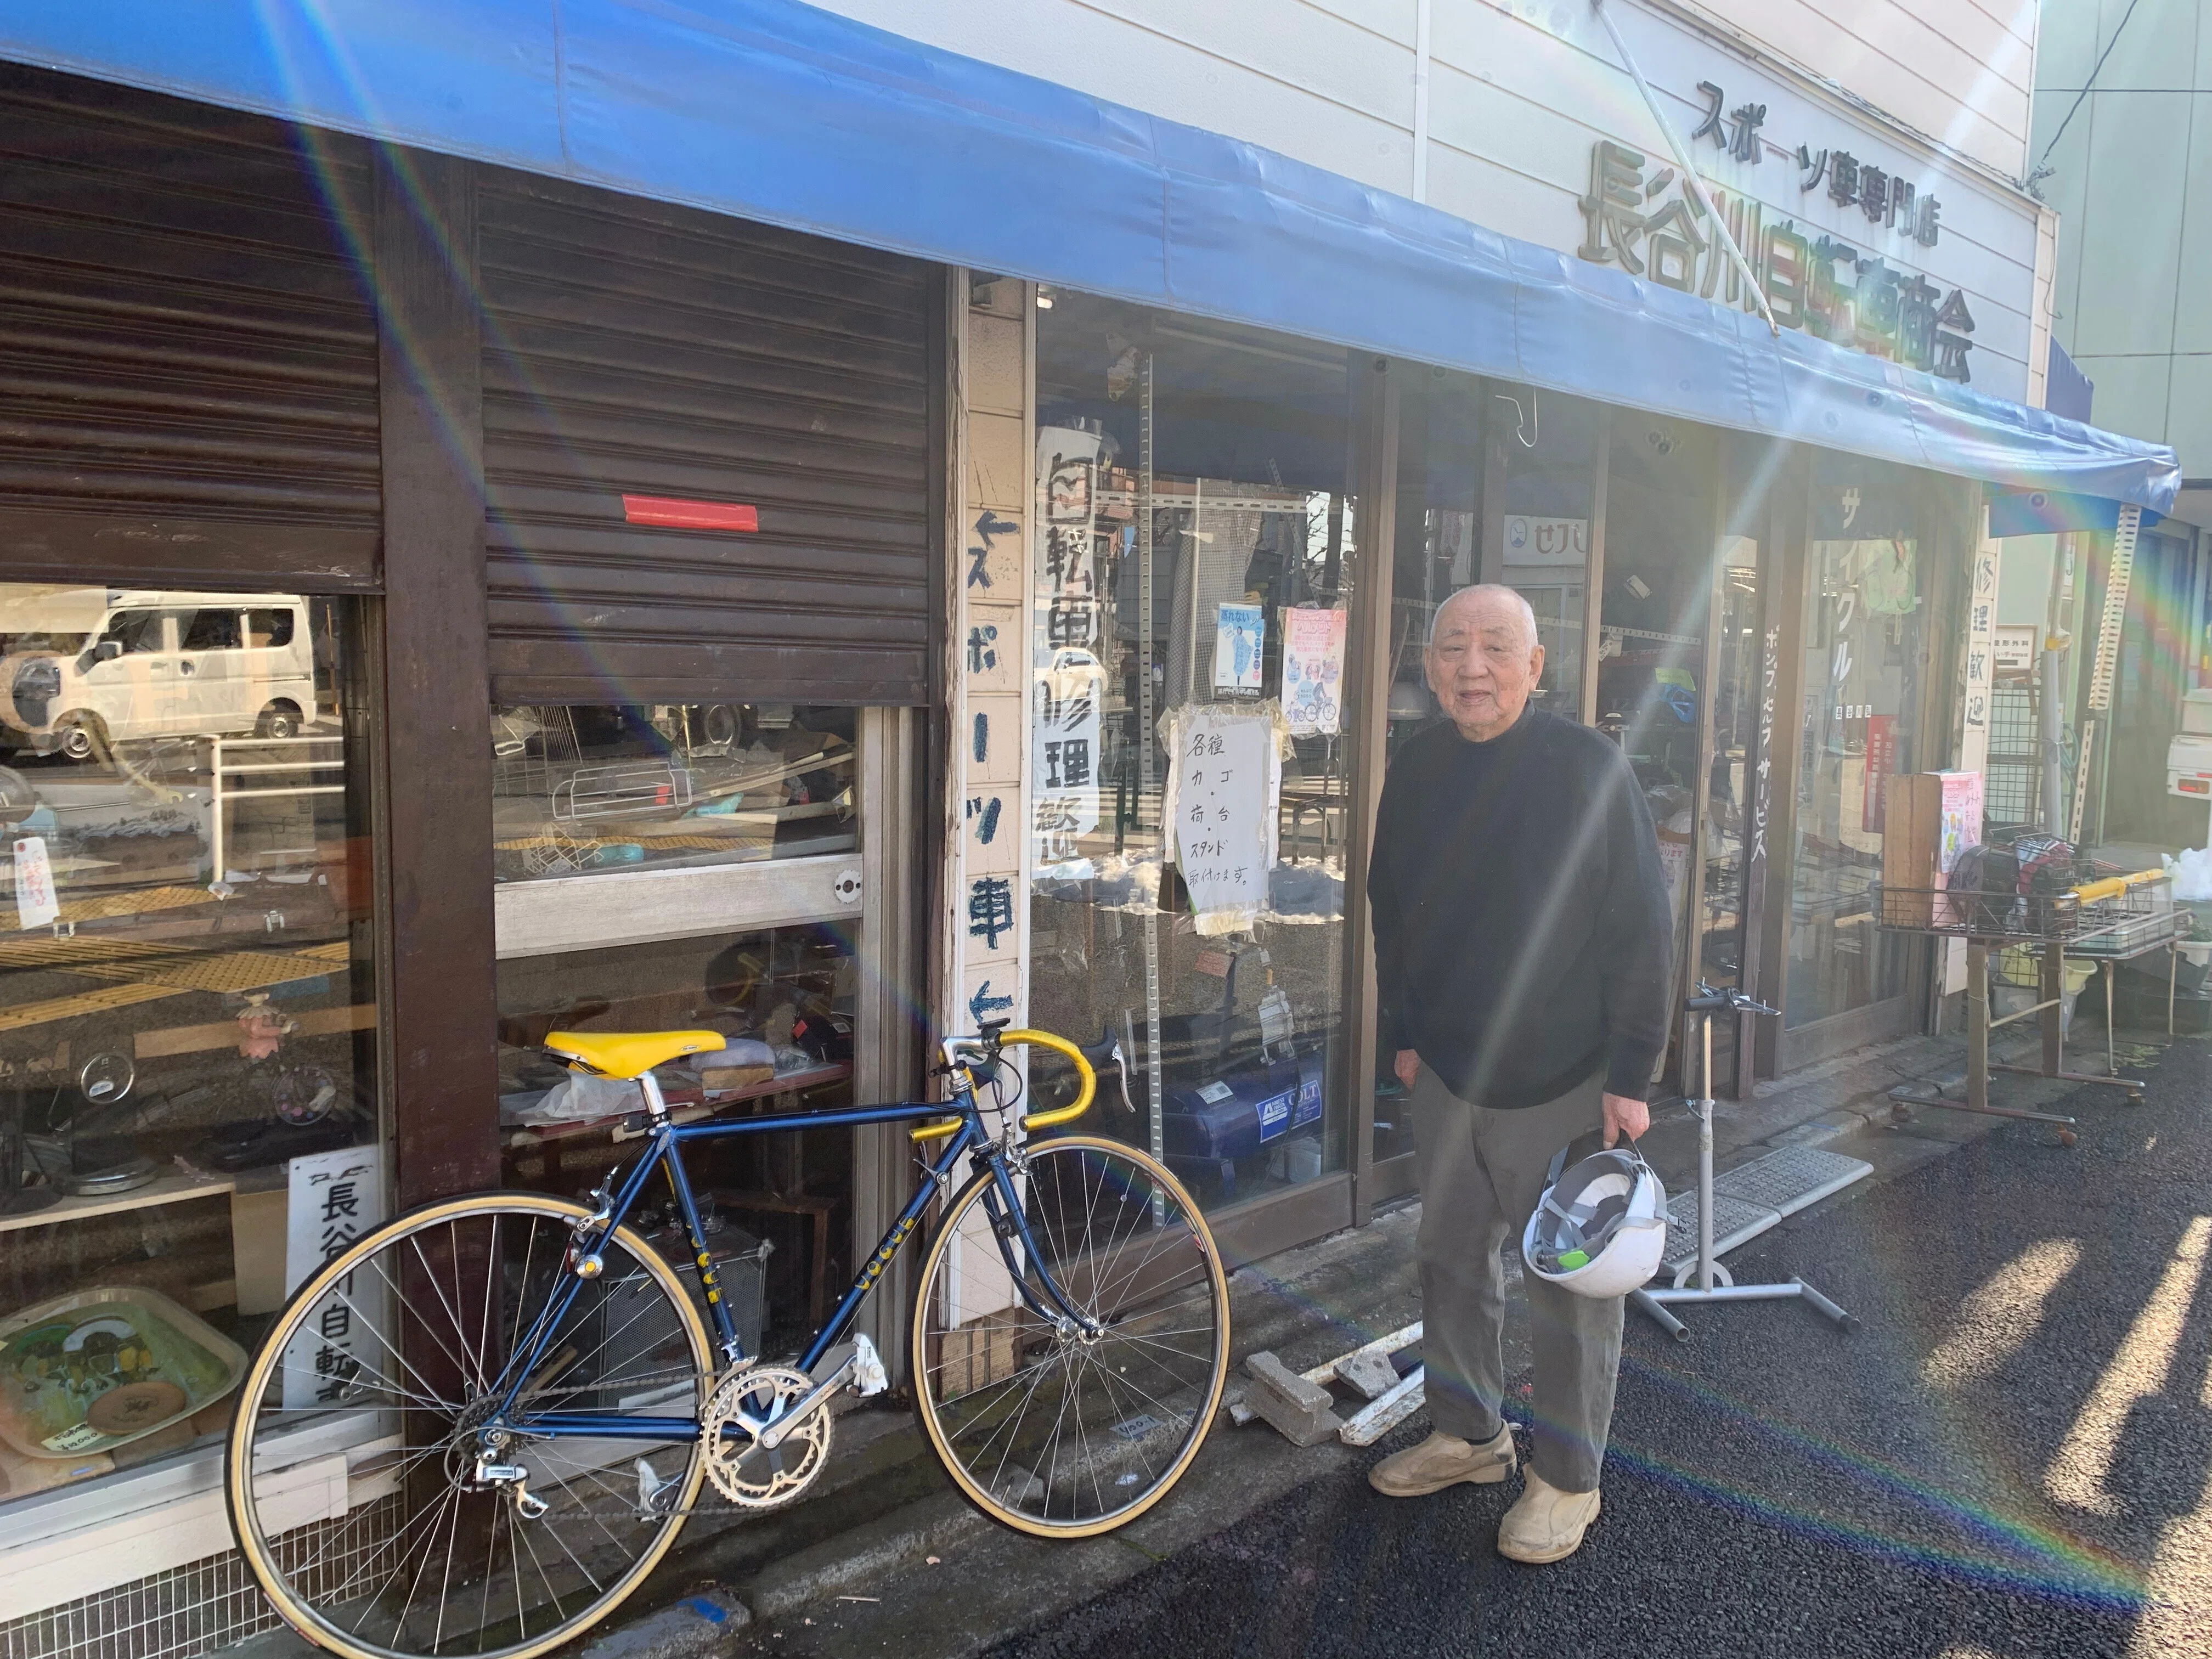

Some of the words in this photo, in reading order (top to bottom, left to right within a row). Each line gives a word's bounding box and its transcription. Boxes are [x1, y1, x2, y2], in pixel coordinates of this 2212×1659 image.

[1833, 487, 1861, 682] サイクル
[1220, 610, 1249, 622] 蒸れない
[1297, 621, 1331, 634] ヘルメット
[1966, 557, 1994, 726] 修理歓迎
[1187, 733, 1225, 757] 各種
[1190, 839, 1228, 858] スタンド
[1188, 866, 1248, 888] 取付けます。
